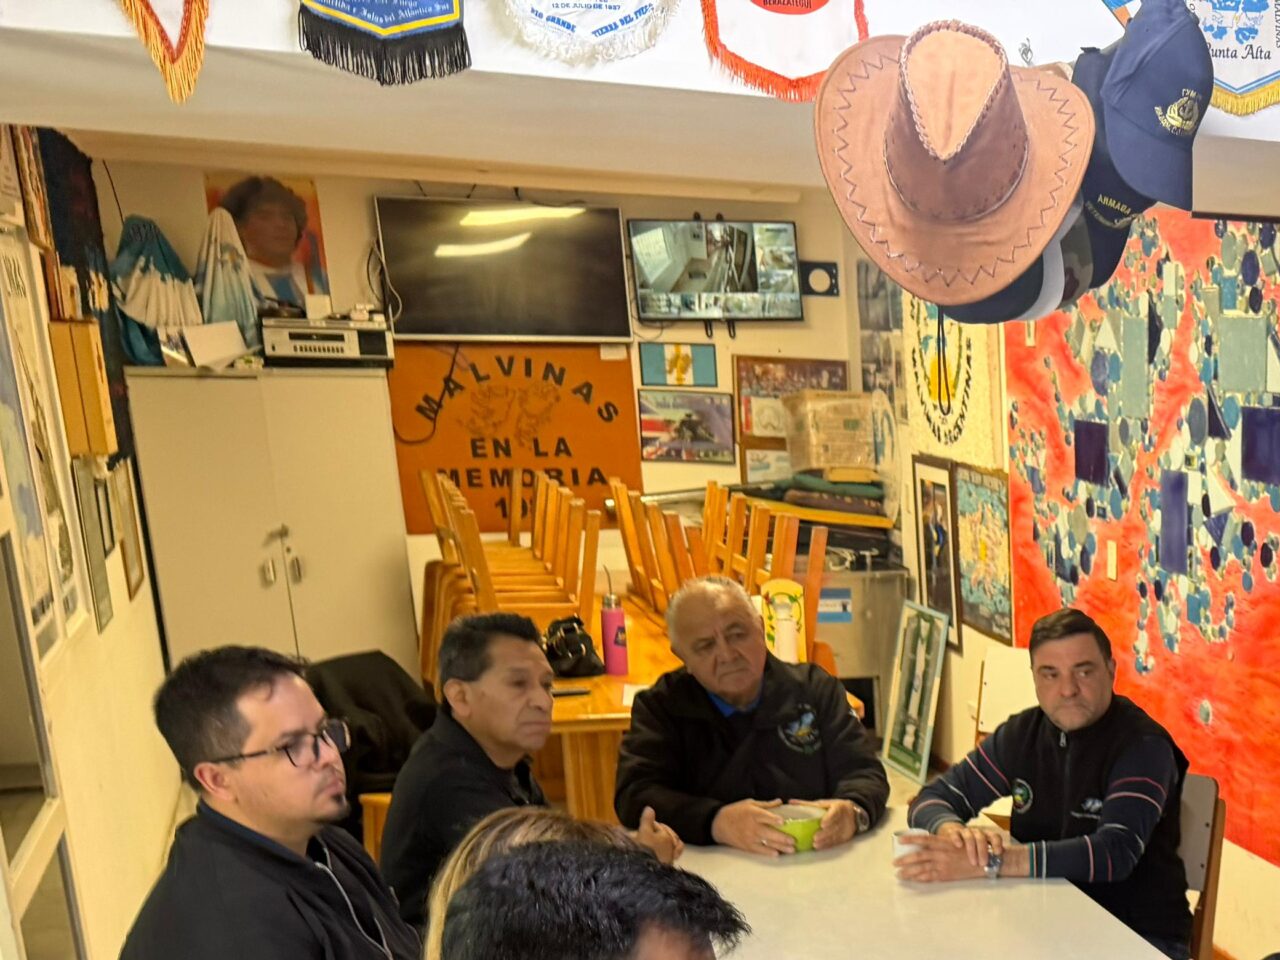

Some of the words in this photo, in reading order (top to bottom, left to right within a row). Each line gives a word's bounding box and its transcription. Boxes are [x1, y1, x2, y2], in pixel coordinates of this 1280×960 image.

[545, 15, 577, 33] GRANDE
[1241, 44, 1271, 60] Alta
[415, 355, 620, 423] MALVINAS
[471, 437, 512, 459] EN
[533, 437, 573, 458] LA
